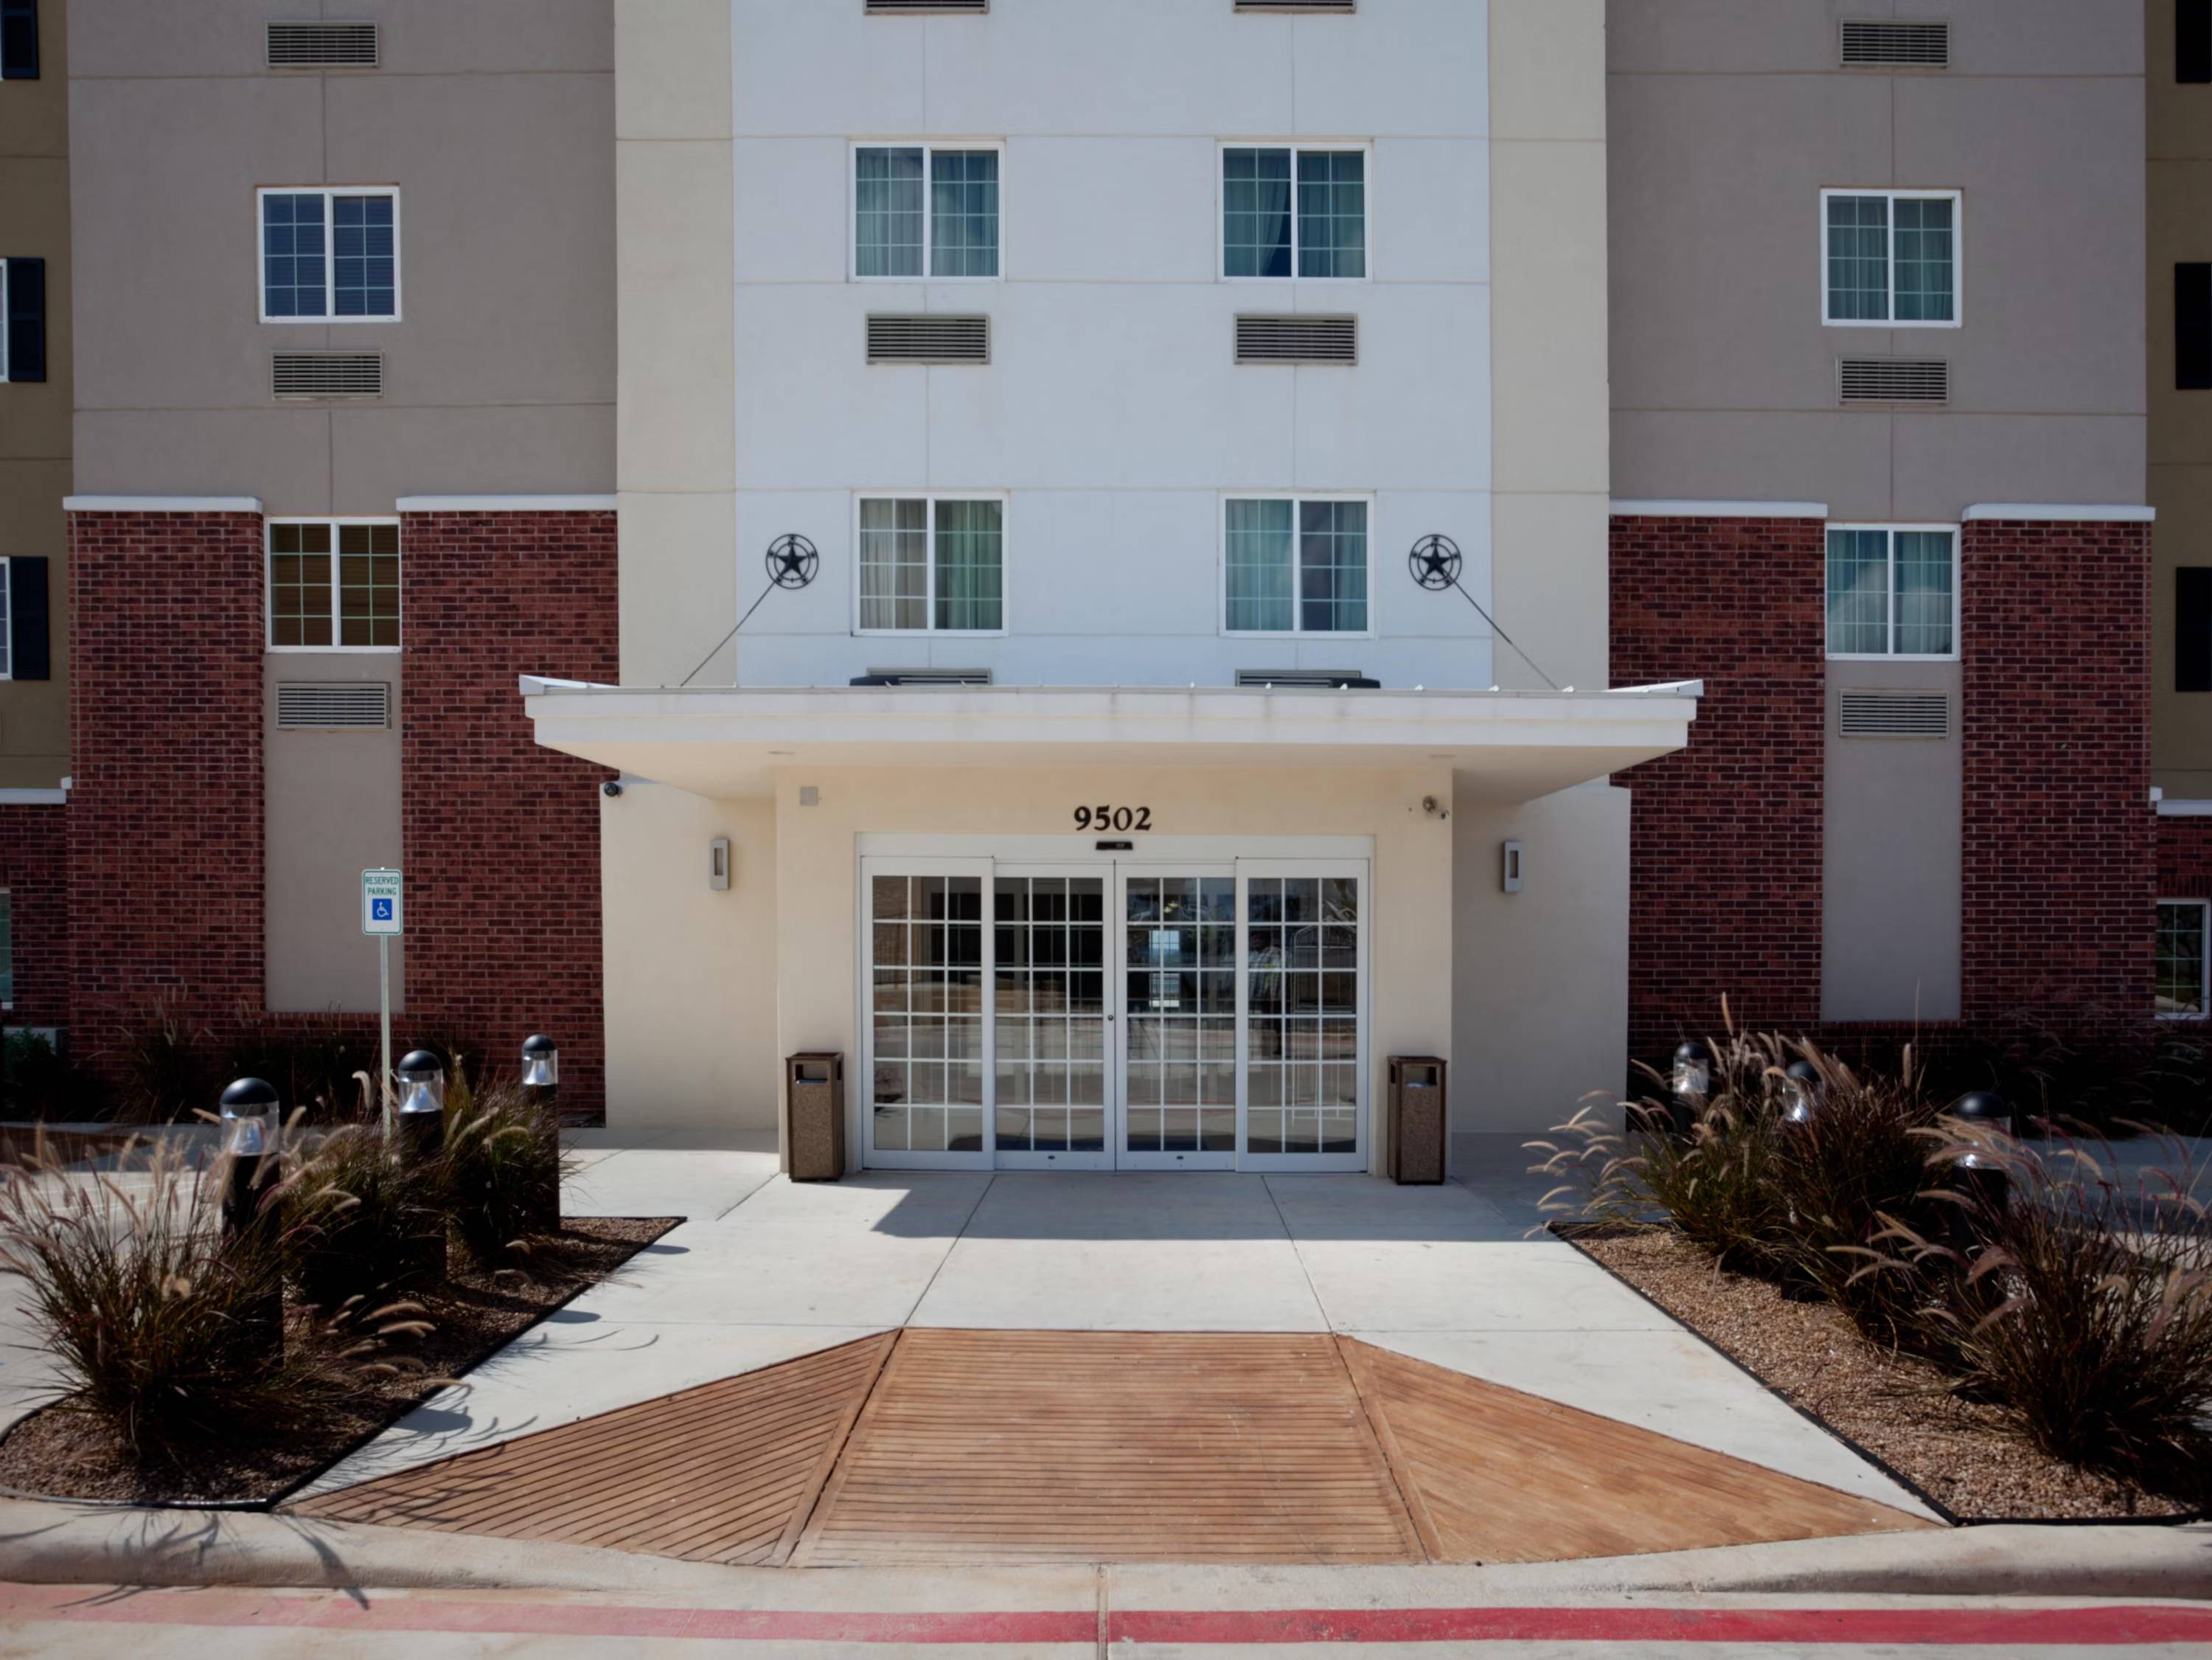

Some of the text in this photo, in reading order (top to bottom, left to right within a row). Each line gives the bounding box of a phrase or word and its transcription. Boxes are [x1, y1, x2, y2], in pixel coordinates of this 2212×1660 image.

[1074, 805, 1152, 831] 9502
[366, 876, 398, 884] RESERVED
[368, 887, 397, 895] PARKING
